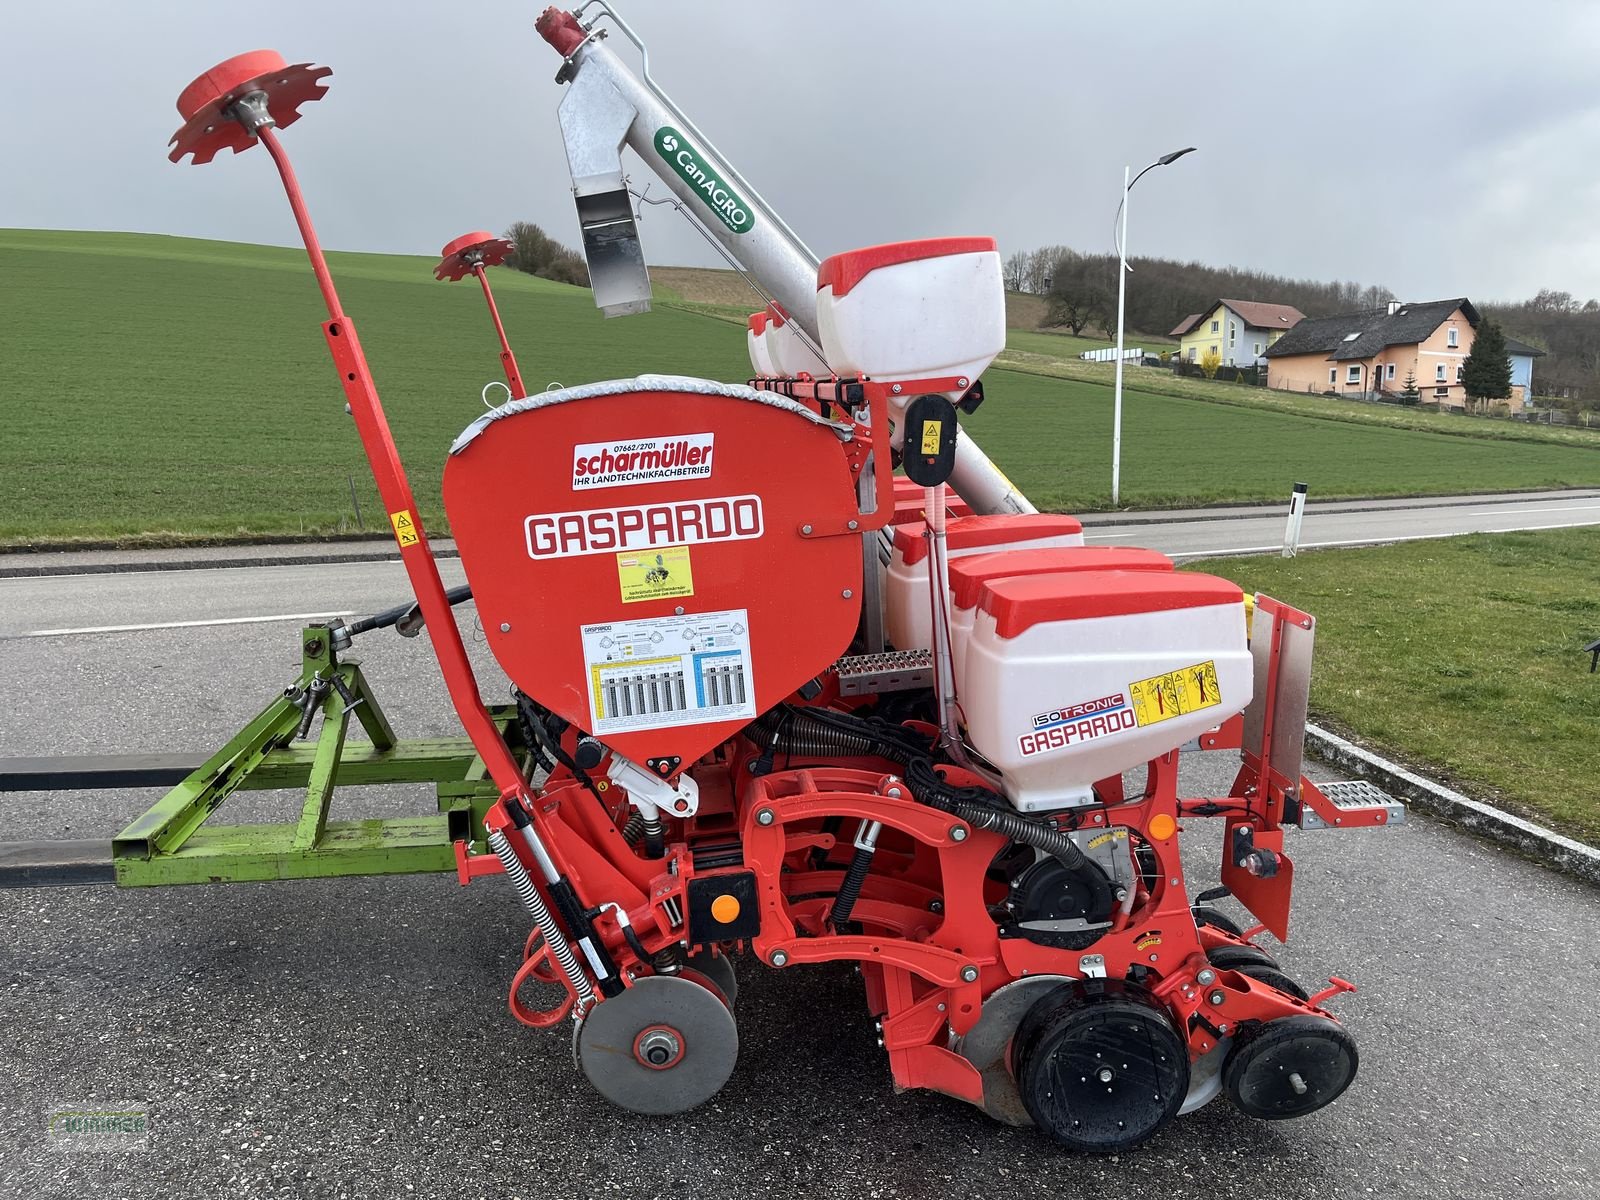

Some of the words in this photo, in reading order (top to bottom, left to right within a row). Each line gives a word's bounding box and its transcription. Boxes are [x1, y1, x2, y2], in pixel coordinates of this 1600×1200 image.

[676, 150, 747, 225] CanAGRO
[575, 440, 712, 476] scharmüller
[613, 442, 656, 453] 07662/2701
[574, 477, 590, 486] IHR
[592, 465, 710, 484] LANDTECHNIKFACHBETRIEB
[528, 498, 761, 556] GASPARDO
[1034, 694, 1123, 726] ISOTRONIC
[1020, 708, 1136, 755] GASPARDO
